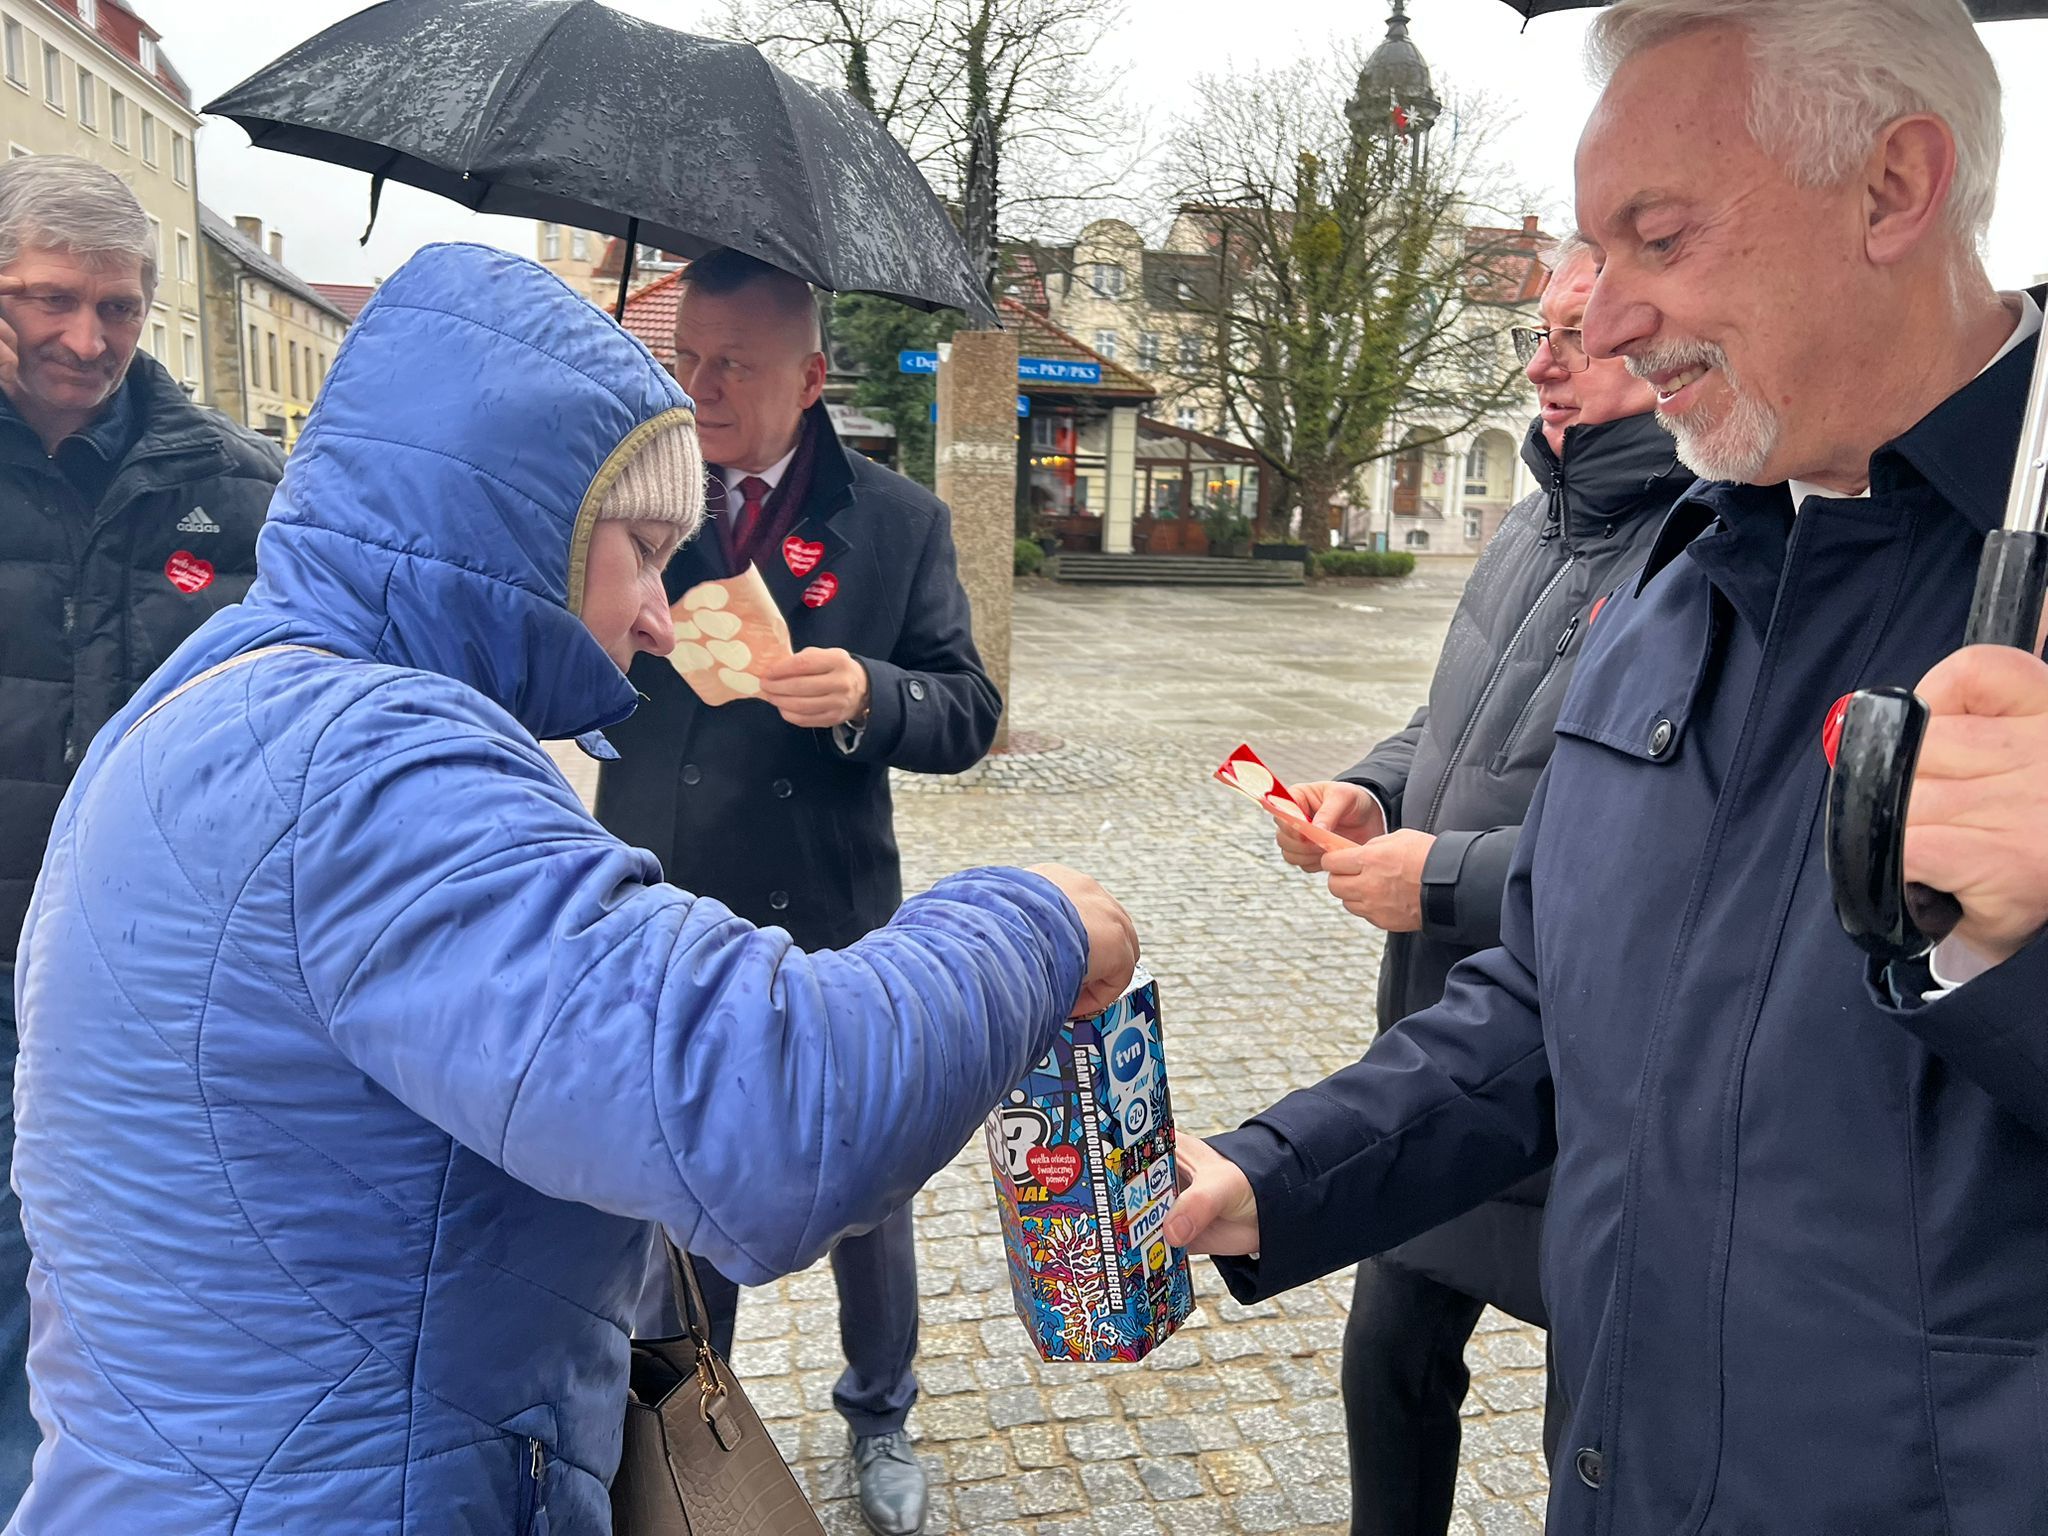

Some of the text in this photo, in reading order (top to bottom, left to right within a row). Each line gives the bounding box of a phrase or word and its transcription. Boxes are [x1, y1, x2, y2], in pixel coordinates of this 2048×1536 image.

[1040, 363, 1096, 379] PKP/PKS
[176, 522, 220, 533] adidas
[1115, 1041, 1141, 1069] tvn
[1073, 1049, 1091, 1089] GRAMY
[1080, 1092, 1095, 1113] DLA
[1129, 1107, 1143, 1124] PZU
[1083, 1115, 1104, 1174] ONKOLOGII
[1030, 1154, 1050, 1164] wielka
[1045, 1177, 1069, 1186] pomocy
[1093, 1183, 1115, 1252] HEMATOLOGII
[1133, 1195, 1170, 1241] max
[1104, 1254, 1123, 1310] DZIECIĘCEJ
